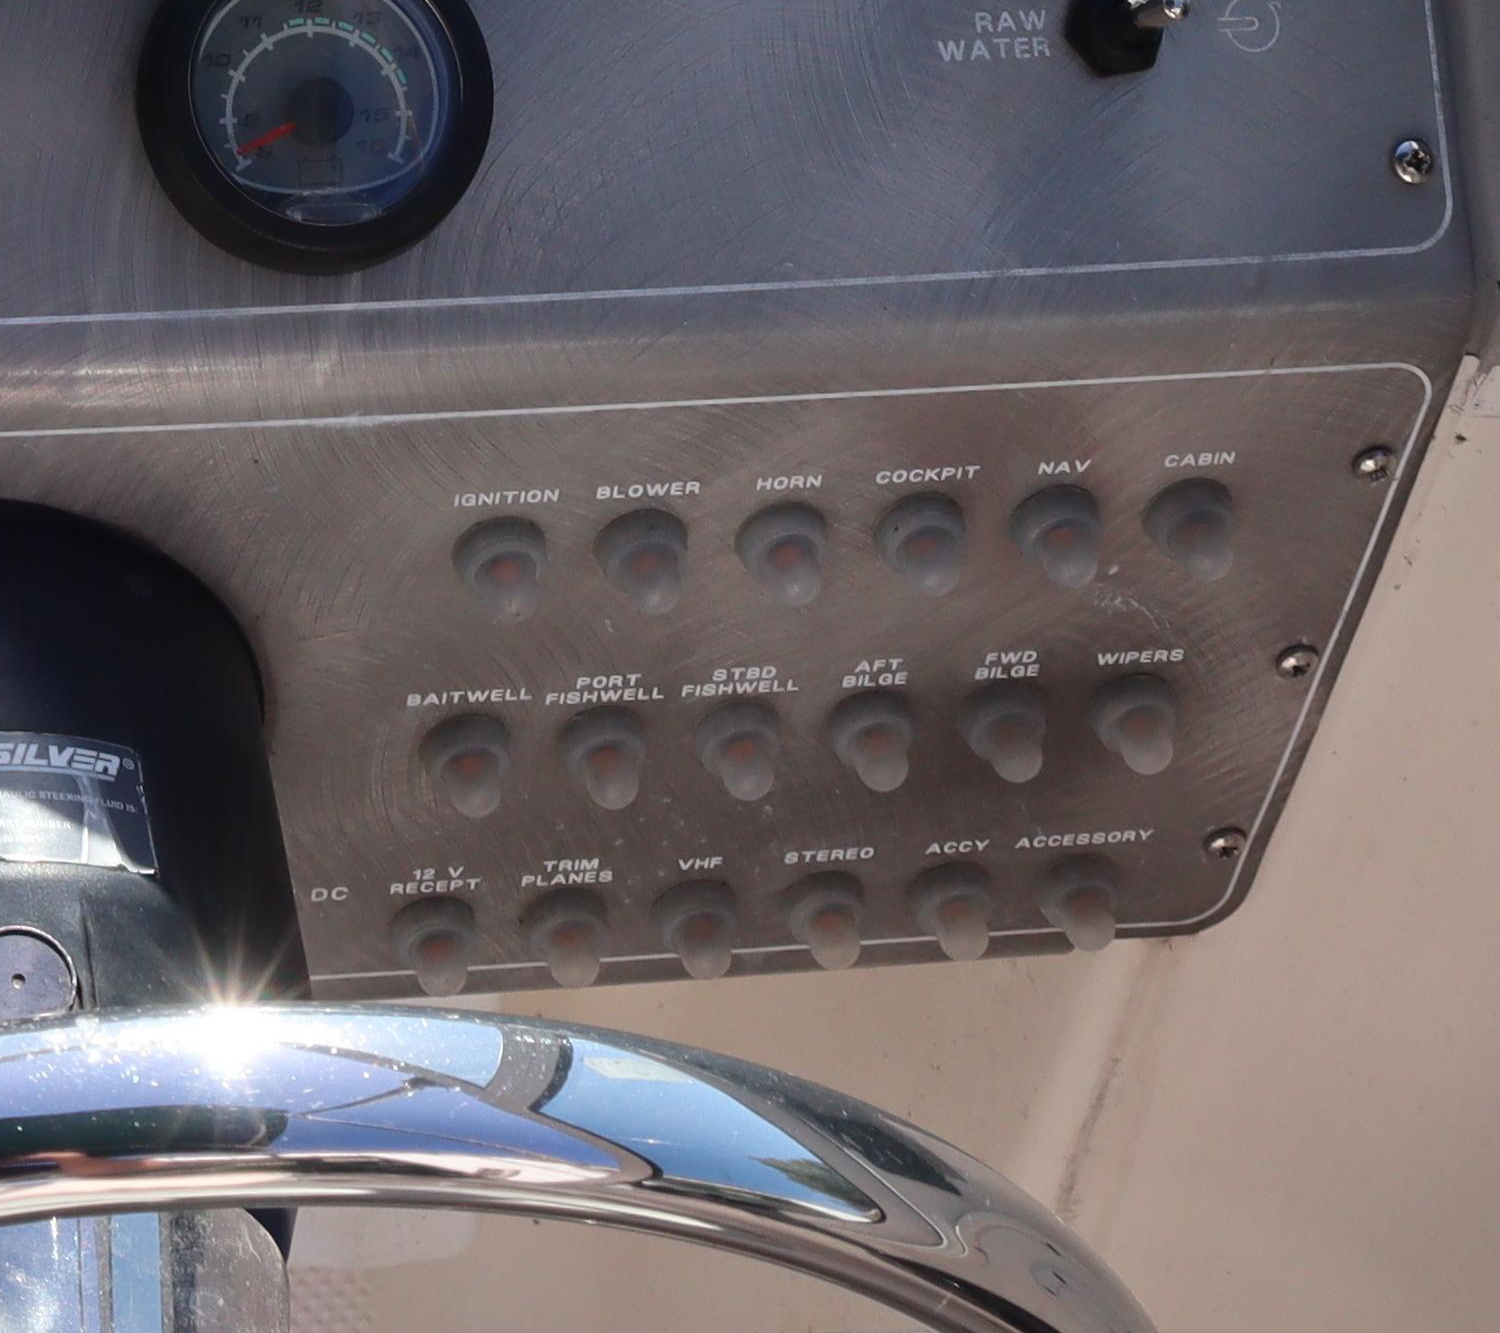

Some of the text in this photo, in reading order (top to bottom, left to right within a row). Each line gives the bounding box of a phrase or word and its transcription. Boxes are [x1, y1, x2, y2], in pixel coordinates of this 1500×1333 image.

[974, 9, 1047, 33] RAW
[937, 37, 1051, 63] WATER
[1037, 458, 1092, 476] NAV
[1164, 451, 1237, 469] CABIN
[756, 474, 824, 492] HORN
[875, 465, 982, 485] COCKPIT
[453, 488, 560, 507] IGNITION
[595, 480, 702, 501] BLOWER
[855, 657, 904, 674] AFT
[984, 649, 1039, 666] FWD
[1097, 648, 1185, 665] WIPERS
[712, 666, 778, 683] STBD
[842, 670, 909, 689] BILGE
[974, 663, 1041, 681] BILGE
[576, 673, 642, 691] PORT
[681, 679, 800, 699] FISHWELL
[406, 686, 533, 709] BAITWELL
[545, 686, 665, 706] FISHWELL
[925, 838, 991, 855] ACCY
[1014, 829, 1155, 850] ACCESSORY
[678, 856, 724, 871] VHF
[784, 846, 875, 865] STEREO
[413, 866, 465, 882] 12 V
[543, 857, 600, 874] TRIM
[389, 877, 482, 895] RECEPT
[521, 869, 613, 887] PLANES
[310, 886, 350, 903] DC
